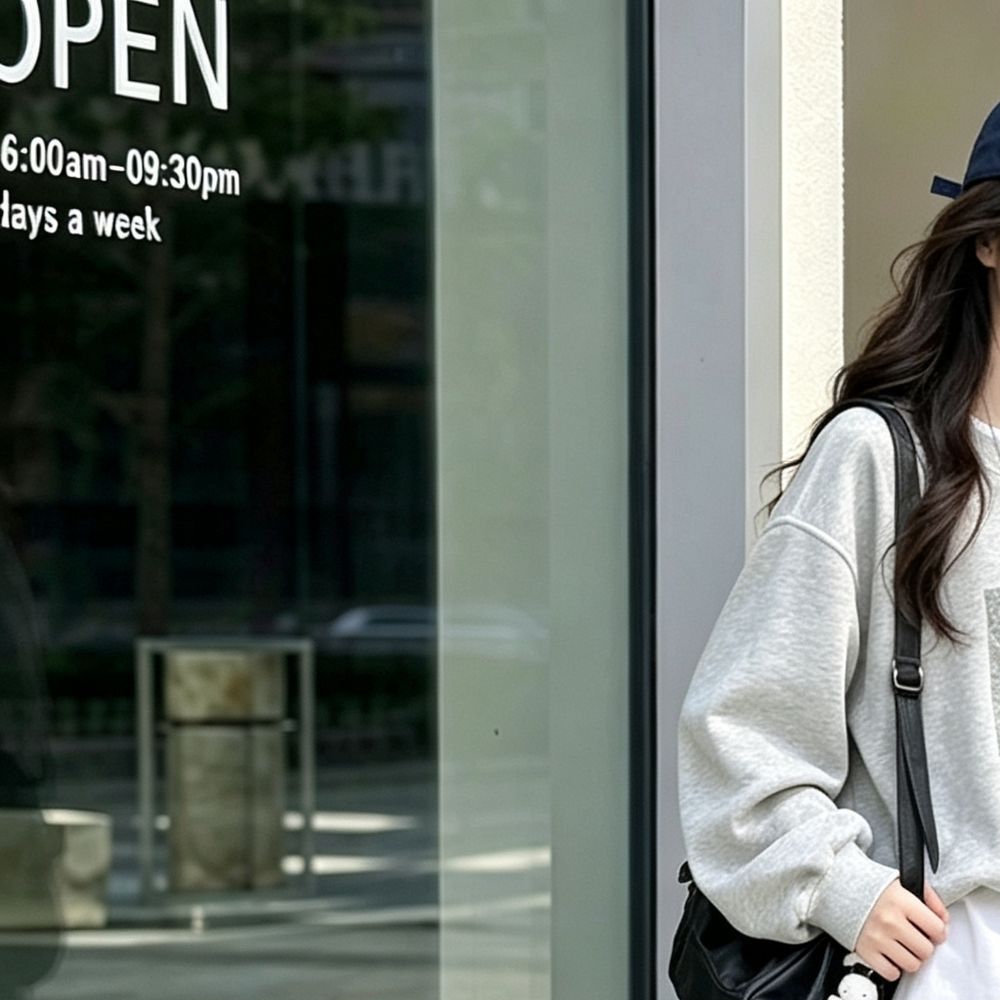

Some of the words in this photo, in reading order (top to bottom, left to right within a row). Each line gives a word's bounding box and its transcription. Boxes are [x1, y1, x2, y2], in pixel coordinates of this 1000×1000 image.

[0, 0, 228, 110] OPEN
[67, 208, 83, 236] a
[93, 205, 162, 242] week
